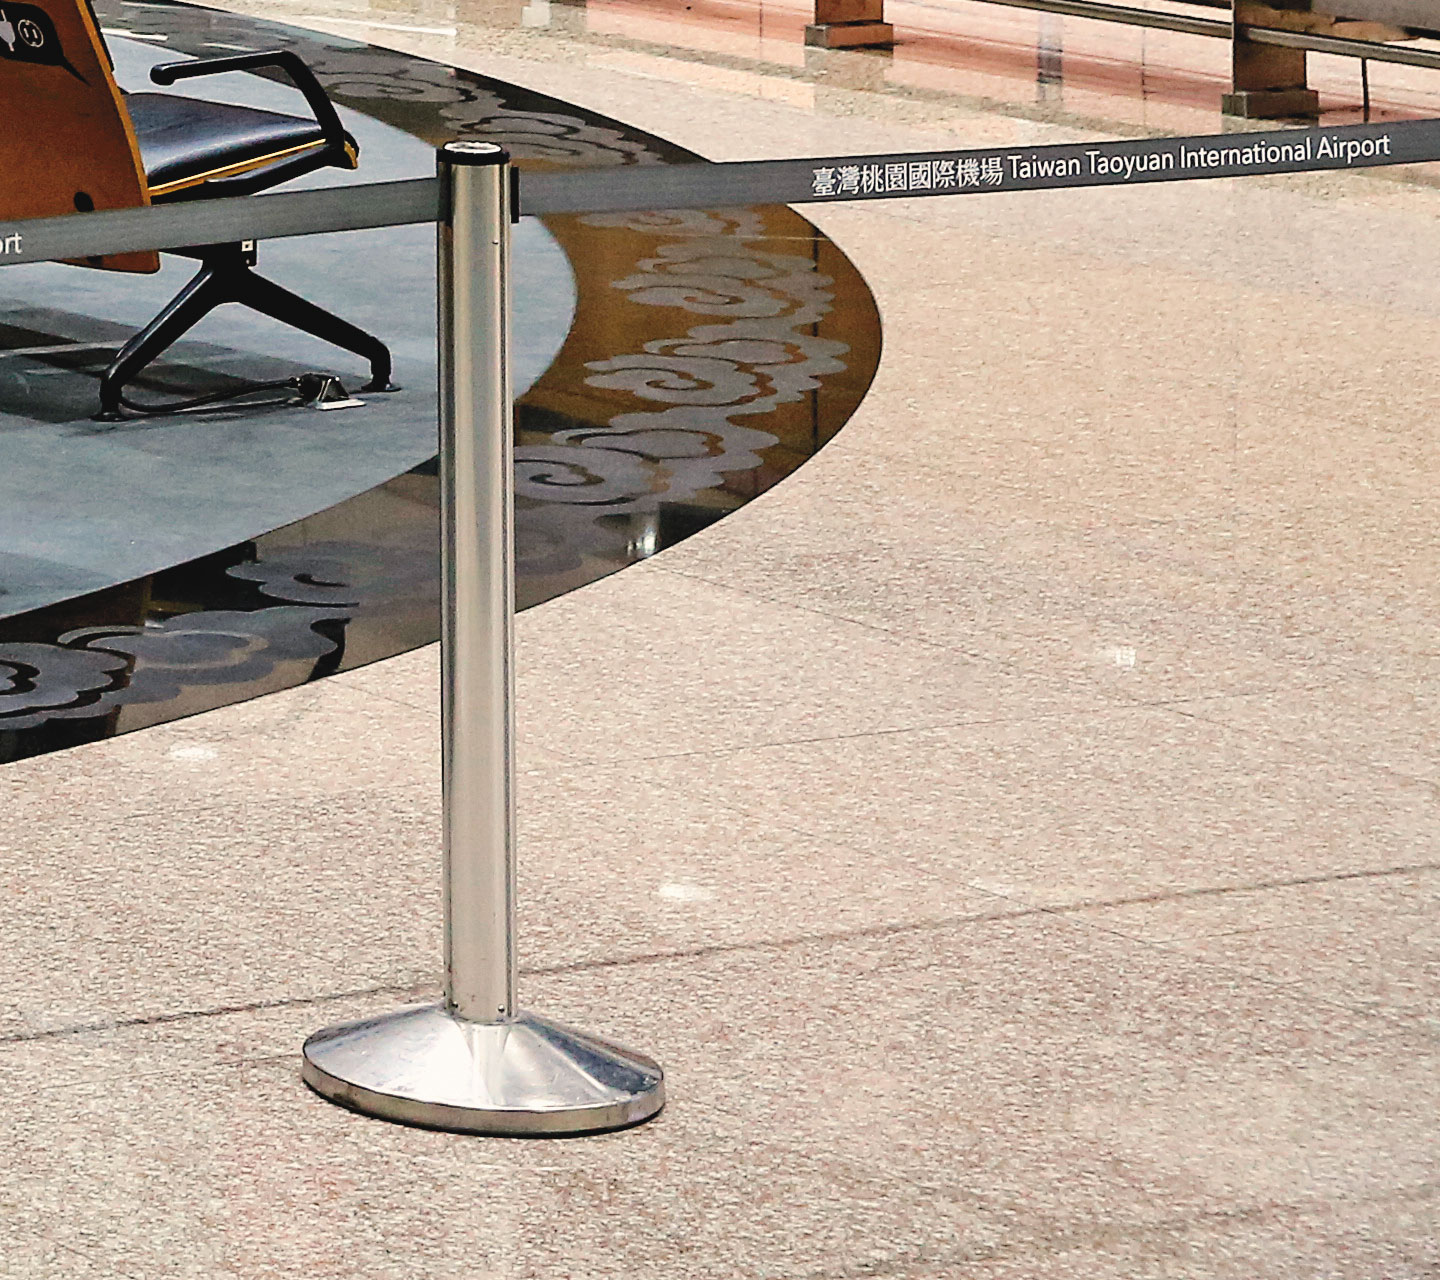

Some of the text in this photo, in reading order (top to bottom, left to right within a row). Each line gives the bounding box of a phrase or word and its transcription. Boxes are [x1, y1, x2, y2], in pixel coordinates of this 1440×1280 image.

[812, 134, 1391, 197] 臺灣桃園國際機場 Taiwan Taoyuan International Airport
